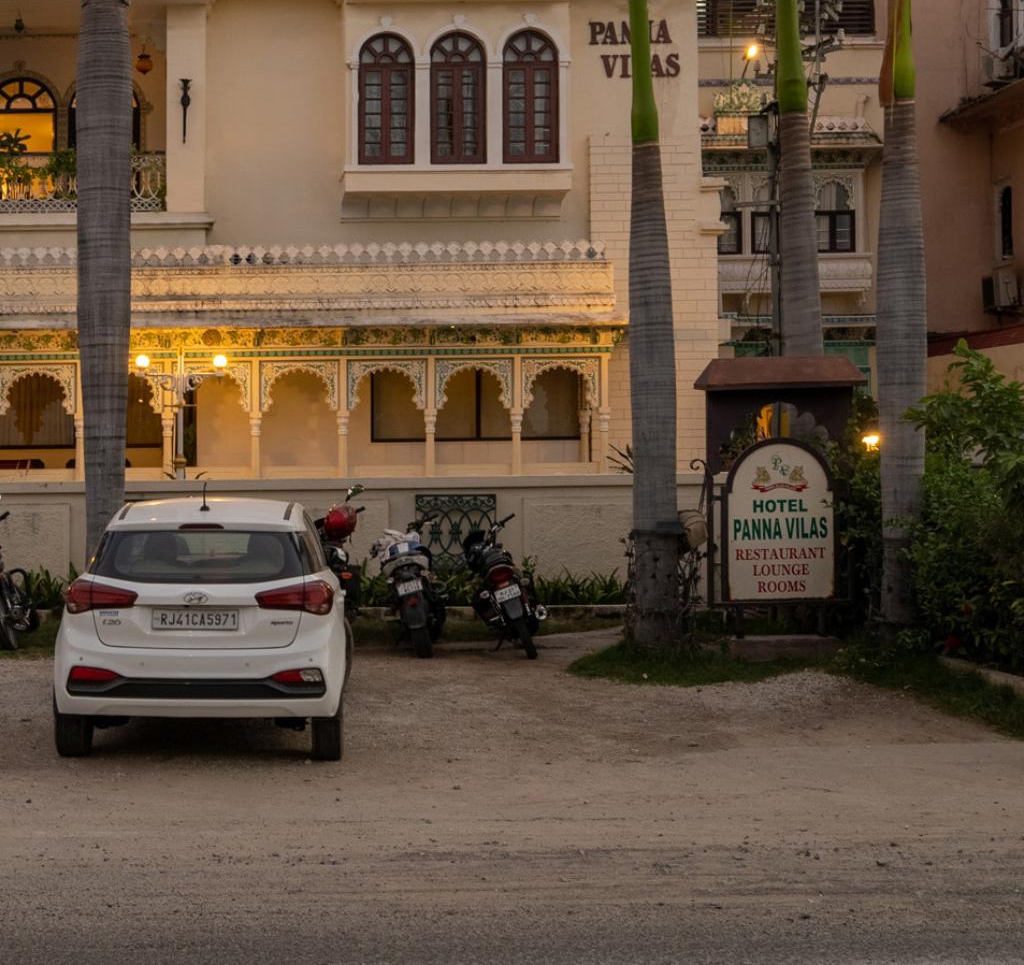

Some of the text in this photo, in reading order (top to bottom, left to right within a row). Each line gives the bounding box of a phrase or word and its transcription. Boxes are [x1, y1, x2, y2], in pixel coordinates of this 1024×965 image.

[600, 53, 681, 78] VIAS
[752, 499, 808, 513] HOTEL
[733, 516, 828, 541] PANNA VILAS
[735, 546, 826, 561] RESTAURANT
[752, 563, 810, 577] LOUNGE
[757, 580, 807, 593] ROOMS
[160, 613, 237, 626] RJ41CA5971
